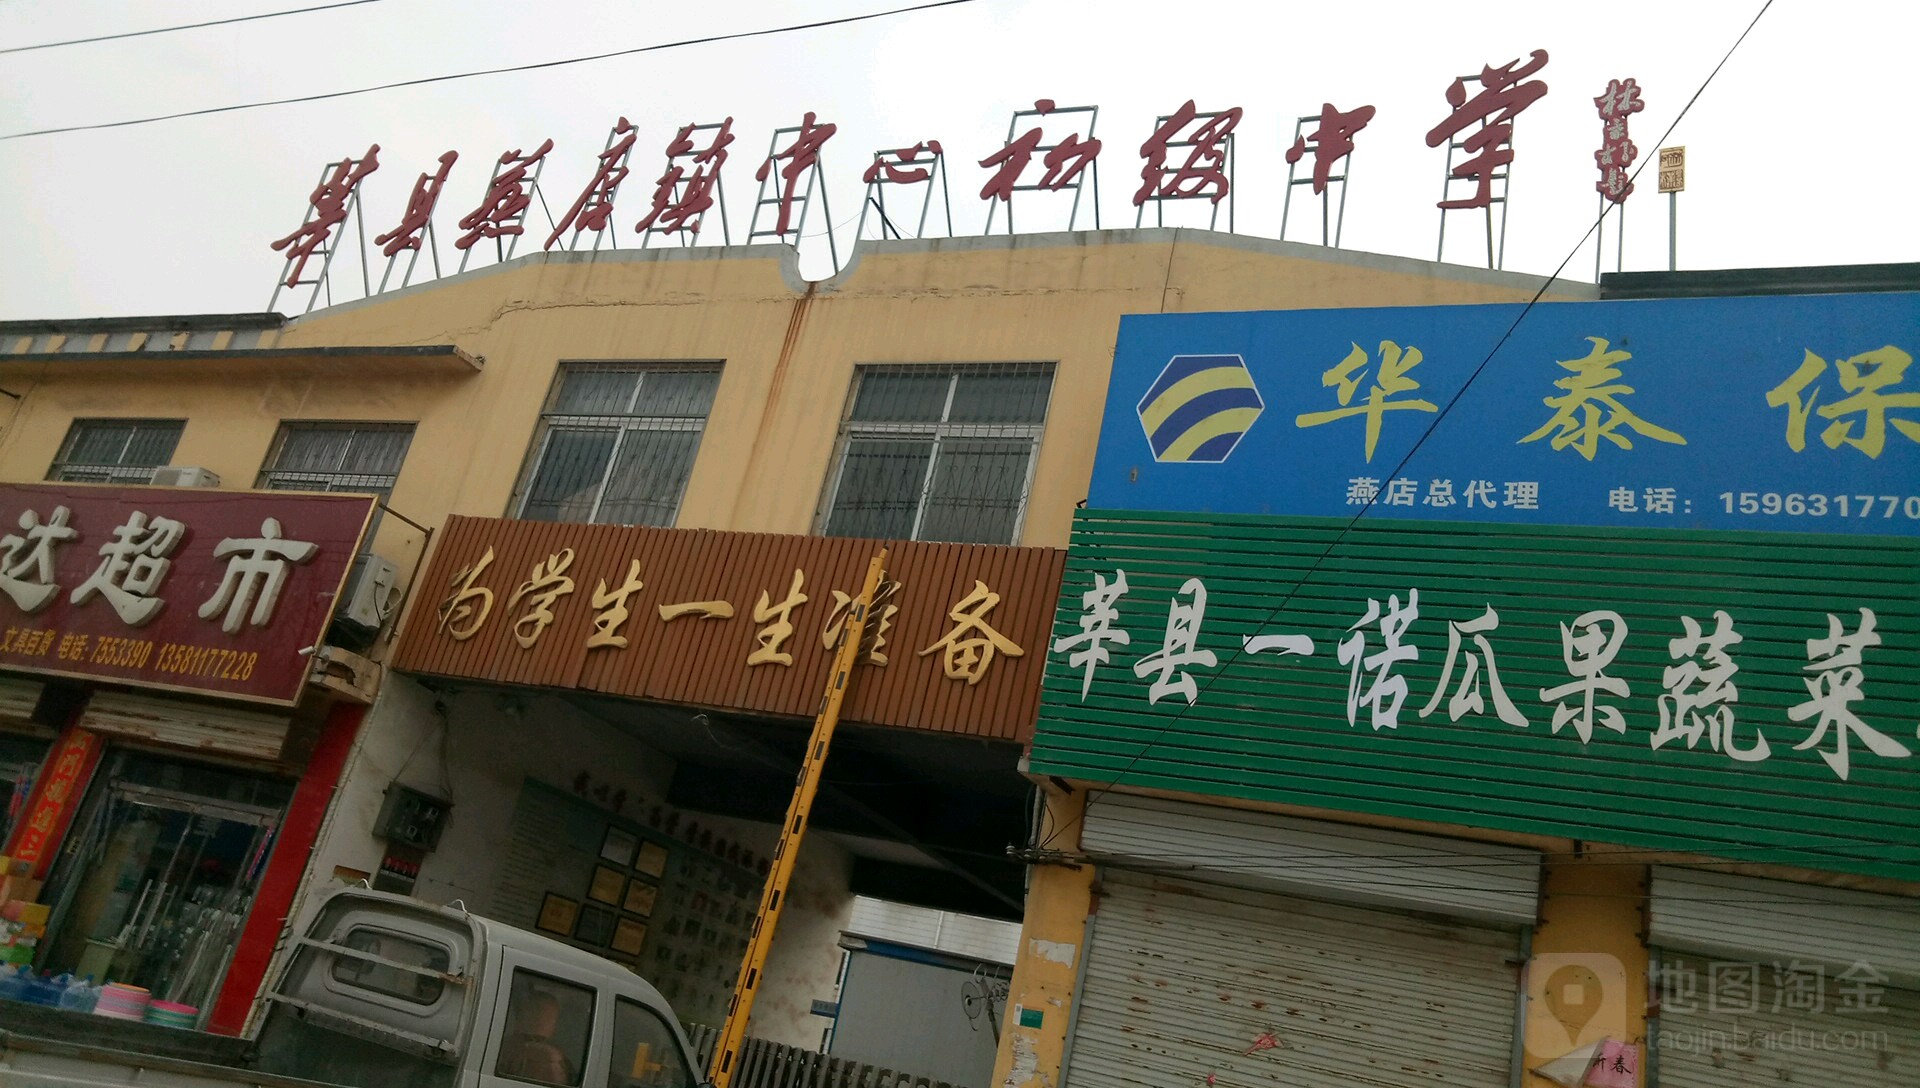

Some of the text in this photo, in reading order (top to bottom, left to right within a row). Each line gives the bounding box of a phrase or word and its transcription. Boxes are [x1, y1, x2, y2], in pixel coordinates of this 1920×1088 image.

[1295, 336, 1920, 464] 华泰保
[1346, 477, 1540, 510] 燕店总代理
[90, 636, 153, 669] 7553390
[155, 643, 258, 682] 13581177228
[438, 545, 1024, 686] 为学生一生准备
[1054, 569, 1920, 782] 莘县一诺瓜果蔬菜
